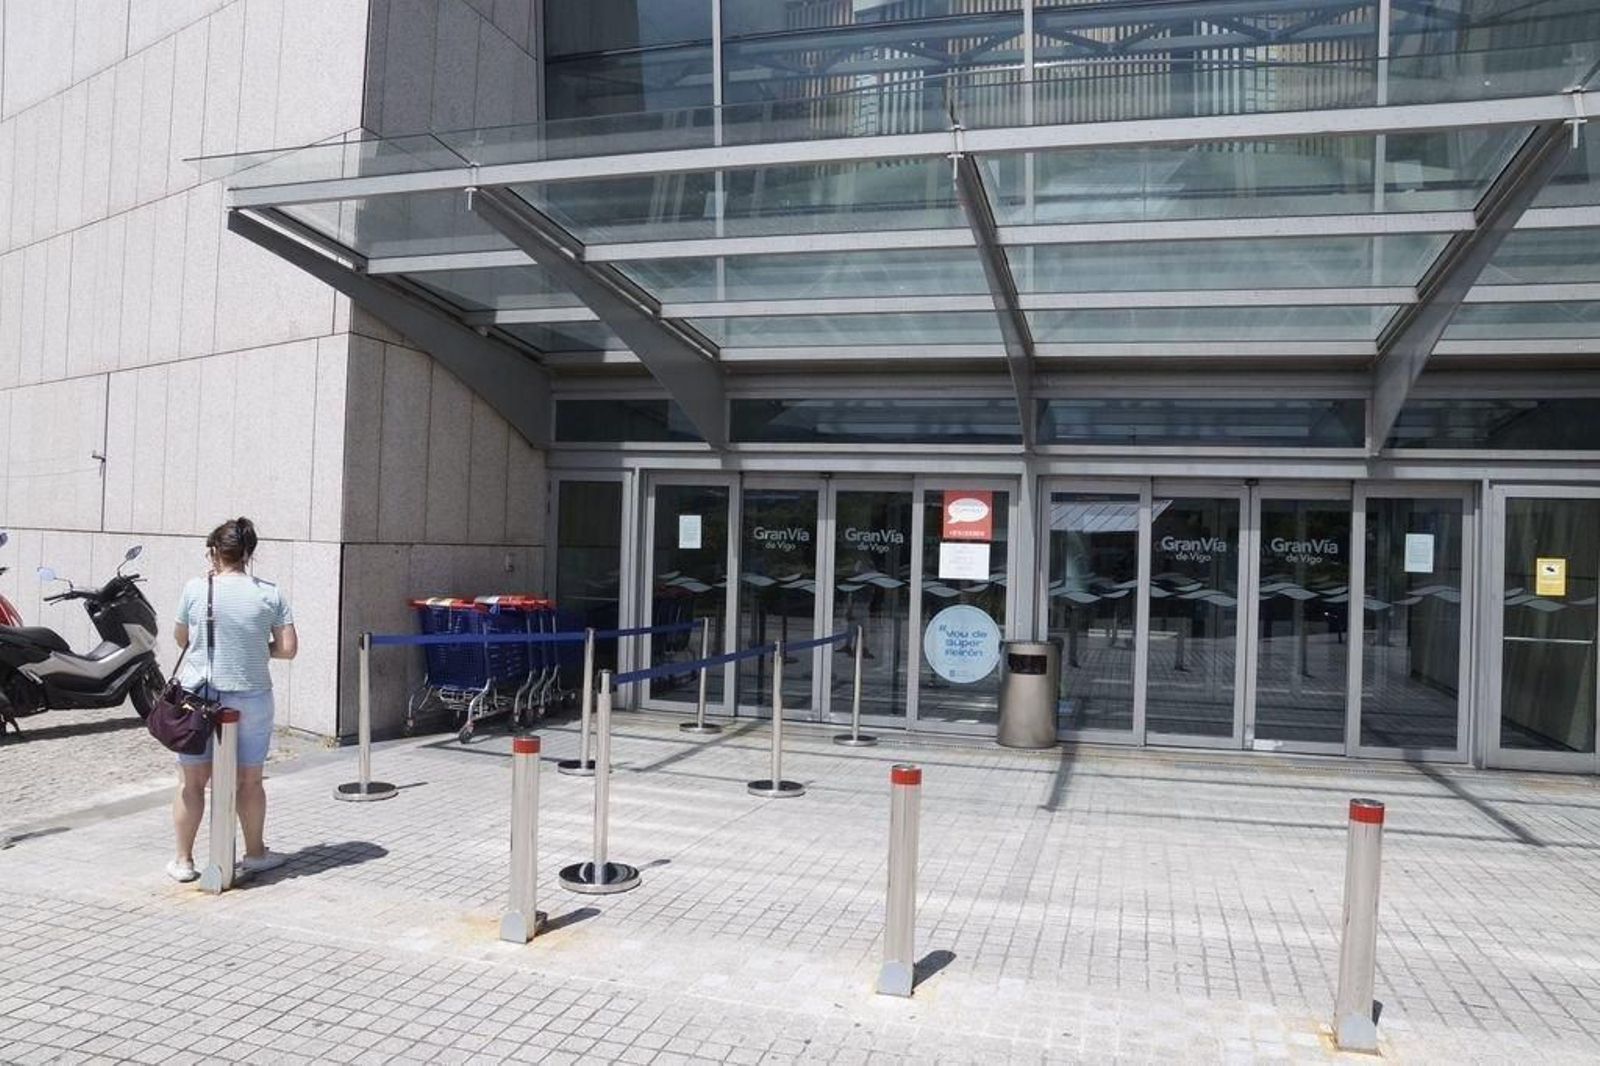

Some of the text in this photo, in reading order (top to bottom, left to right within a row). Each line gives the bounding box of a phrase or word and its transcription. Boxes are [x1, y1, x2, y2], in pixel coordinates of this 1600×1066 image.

[765, 541, 796, 552] de Vigo
[857, 542, 890, 554] de Vigo
[1175, 552, 1212, 563] de Vigo
[1285, 554, 1323, 566] de Vigo
